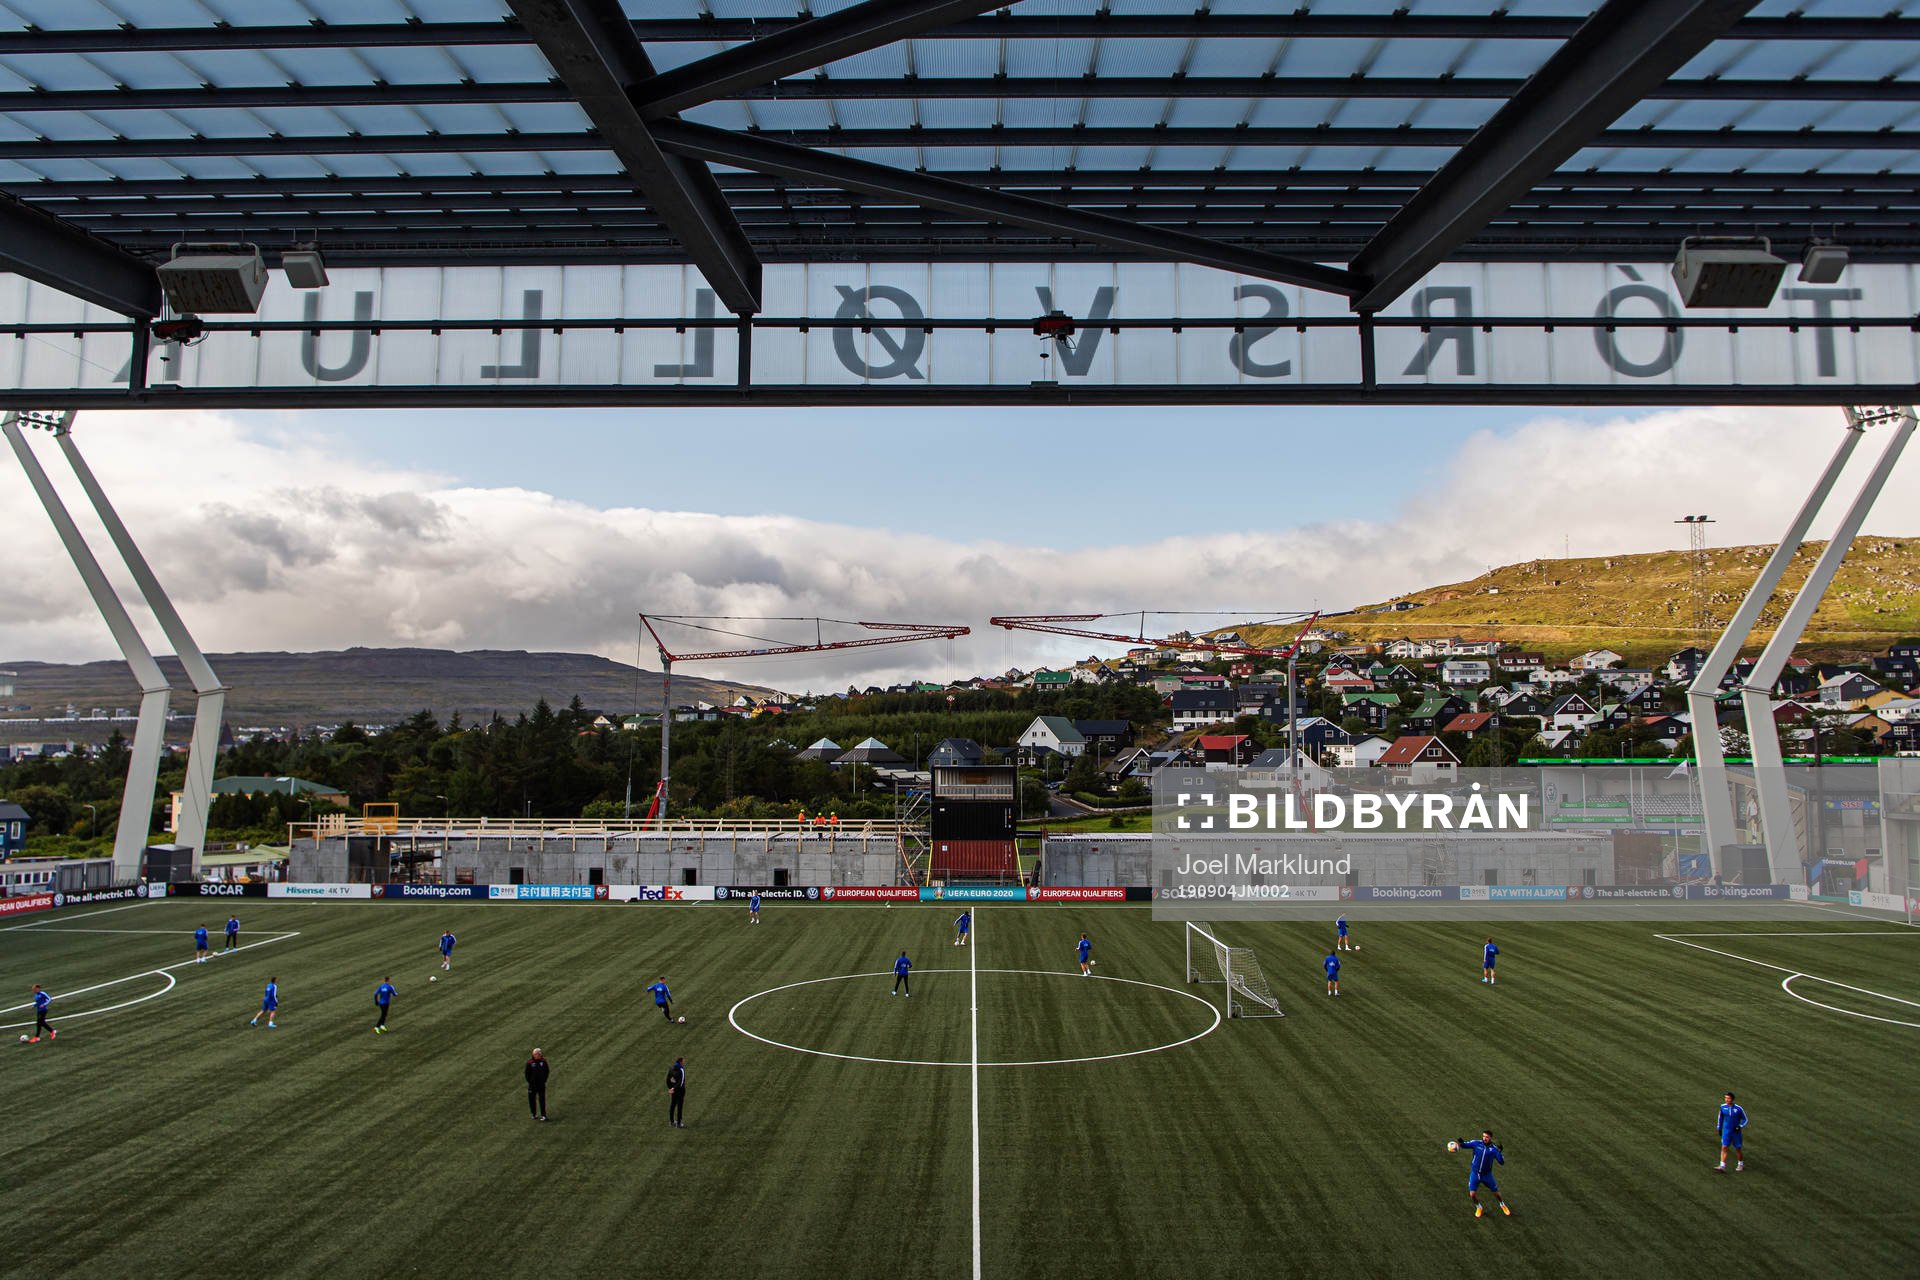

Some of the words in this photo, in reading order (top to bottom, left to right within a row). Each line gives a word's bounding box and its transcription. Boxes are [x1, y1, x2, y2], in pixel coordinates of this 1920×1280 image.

[200, 884, 243, 895] SOCAR
[286, 886, 325, 895] Hisense
[403, 885, 471, 896] Booking.com
[639, 886, 684, 900] FedEx
[730, 889, 746, 897] The
[793, 889, 805, 898] ID.
[837, 889, 875, 897] EUROPEAN
[877, 889, 918, 898] QUALIFIERS
[948, 889, 969, 897] UEFA
[970, 889, 992, 897] EURO
[993, 889, 1014, 897] 2020
[1042, 889, 1081, 897] EUROPEAN
[1082, 889, 1123, 898] QUALIFIERS
[1161, 888, 1206, 899] SOC
[1372, 887, 1442, 899] Booking.com
[1491, 888, 1509, 897] PAY
[1509, 888, 1532, 897] WITH
[1532, 888, 1564, 898] ALIPAY
[1597, 889, 1613, 897] The
[1613, 889, 1658, 897] all-electric
[1659, 889, 1671, 897] ID.
[66, 895, 81, 903] The
[82, 890, 124, 902] all-electric
[124, 889, 136, 898] ID.
[15, 897, 51, 908] QUALIFIERS
